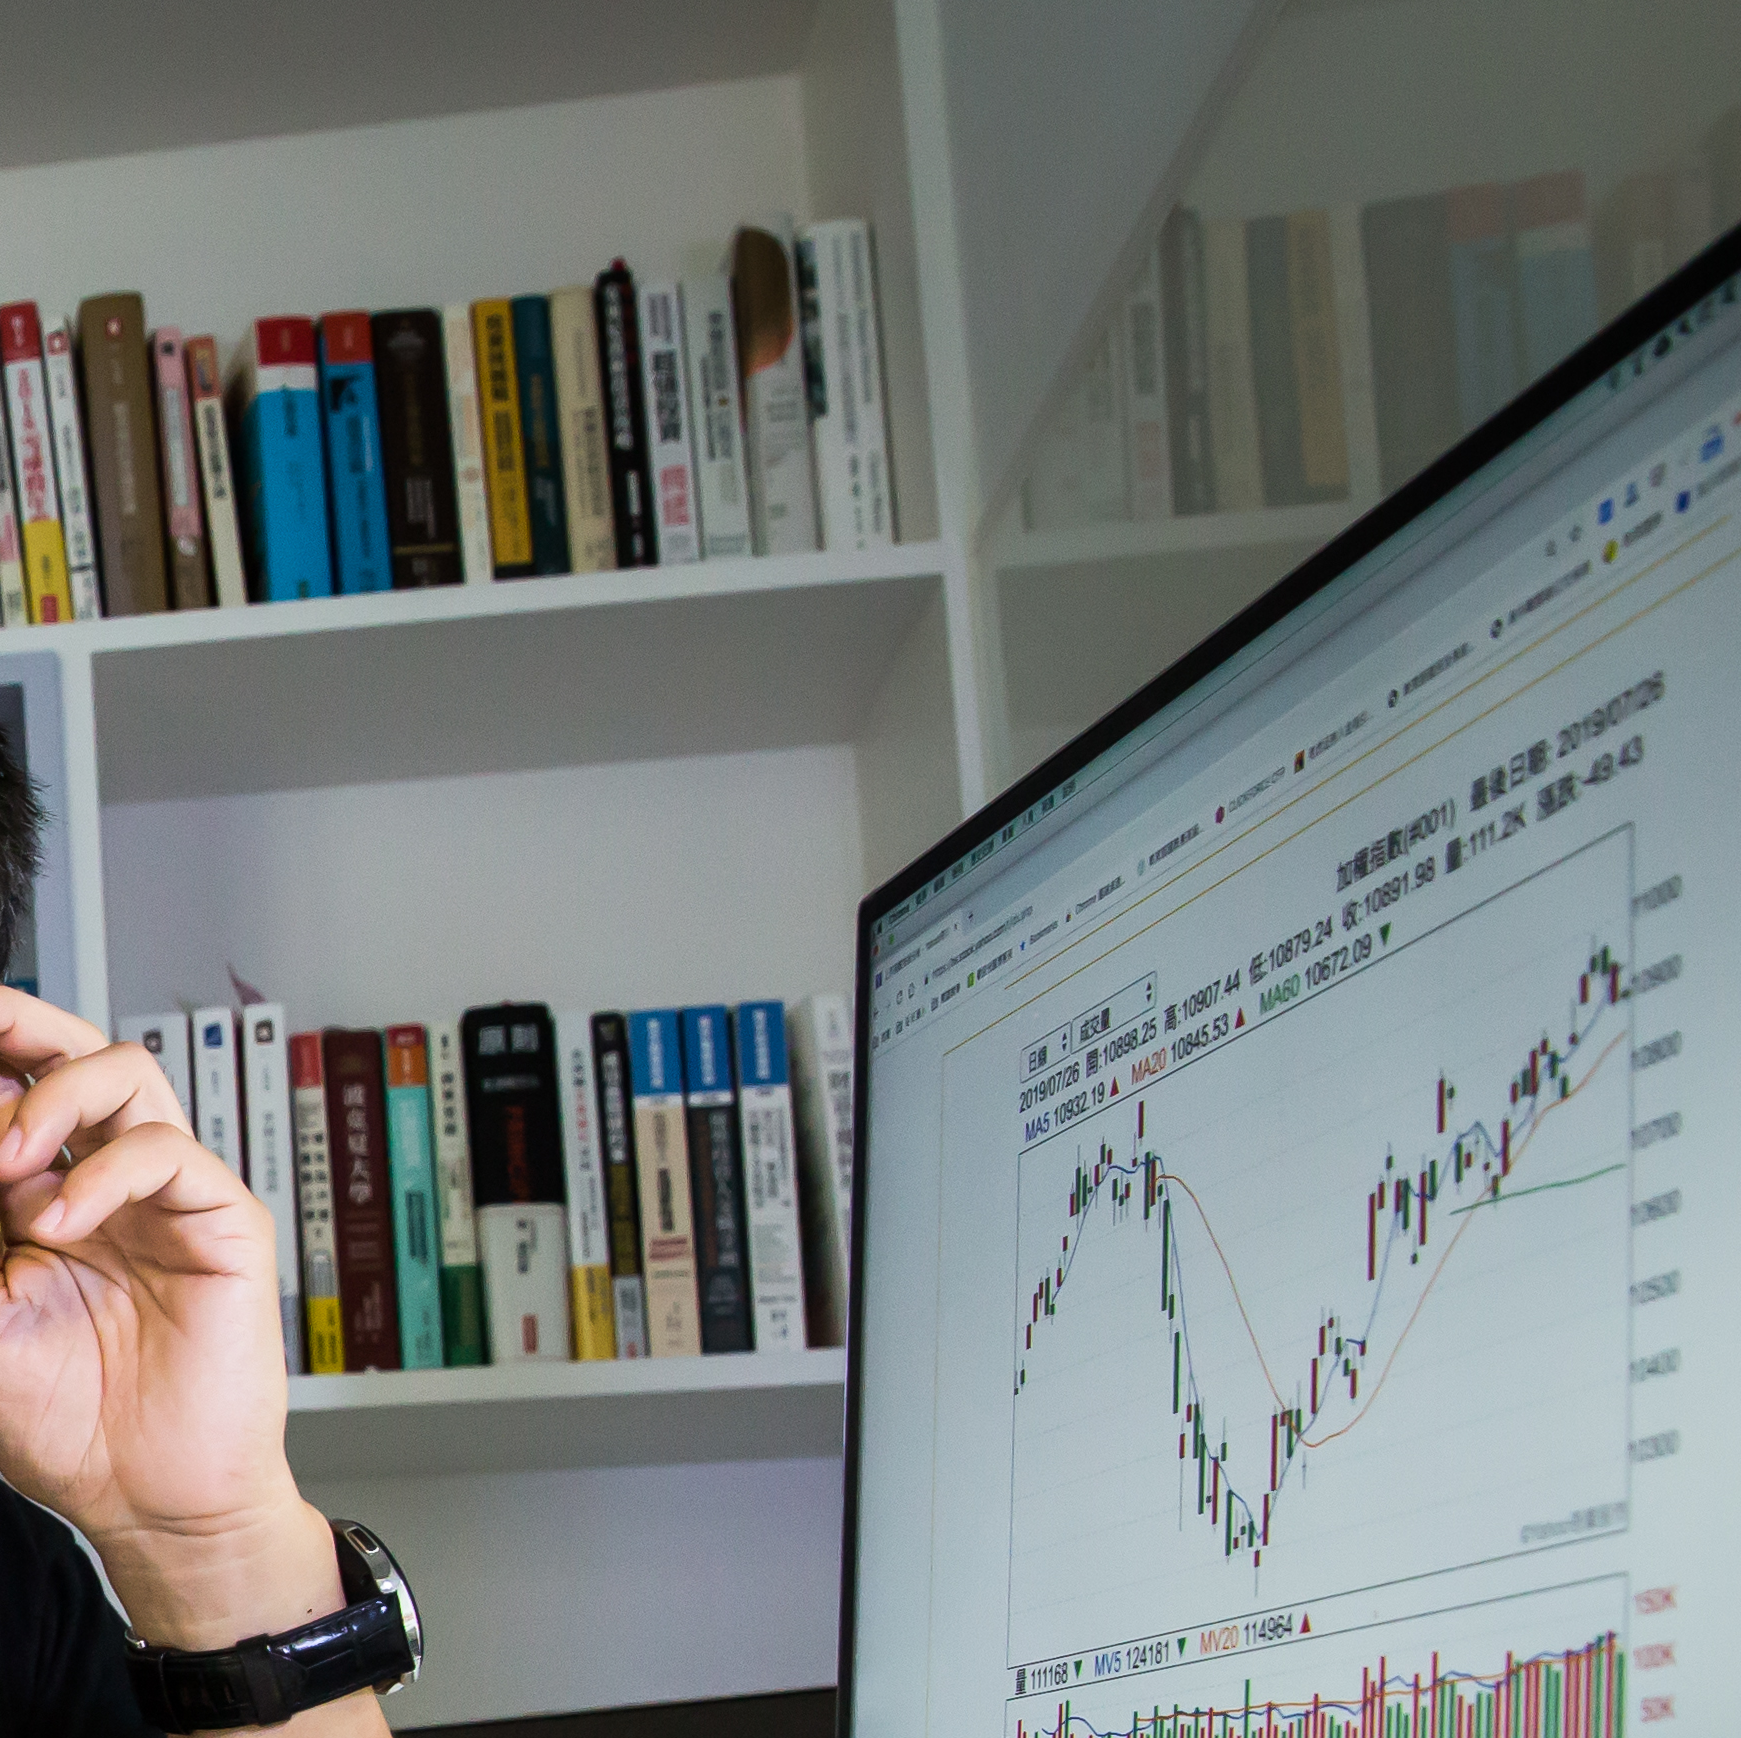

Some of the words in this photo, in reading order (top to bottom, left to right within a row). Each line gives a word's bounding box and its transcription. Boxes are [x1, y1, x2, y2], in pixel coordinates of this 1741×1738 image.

[1024, 1111, 1051, 1144] MA5
[1053, 1081, 1106, 1130] 10932.19
[1130, 1047, 1167, 1086] MA20
[1170, 1012, 1230, 1066] 10845.53
[1304, 933, 1374, 991] 10672.09
[1019, 1060, 1081, 1114] 2019/07/26
[1030, 1660, 1069, 1691] 111168
[1094, 1650, 1122, 1678] MV5
[1125, 1638, 1171, 1671] 124181
[1199, 1624, 1240, 1655] MV20
